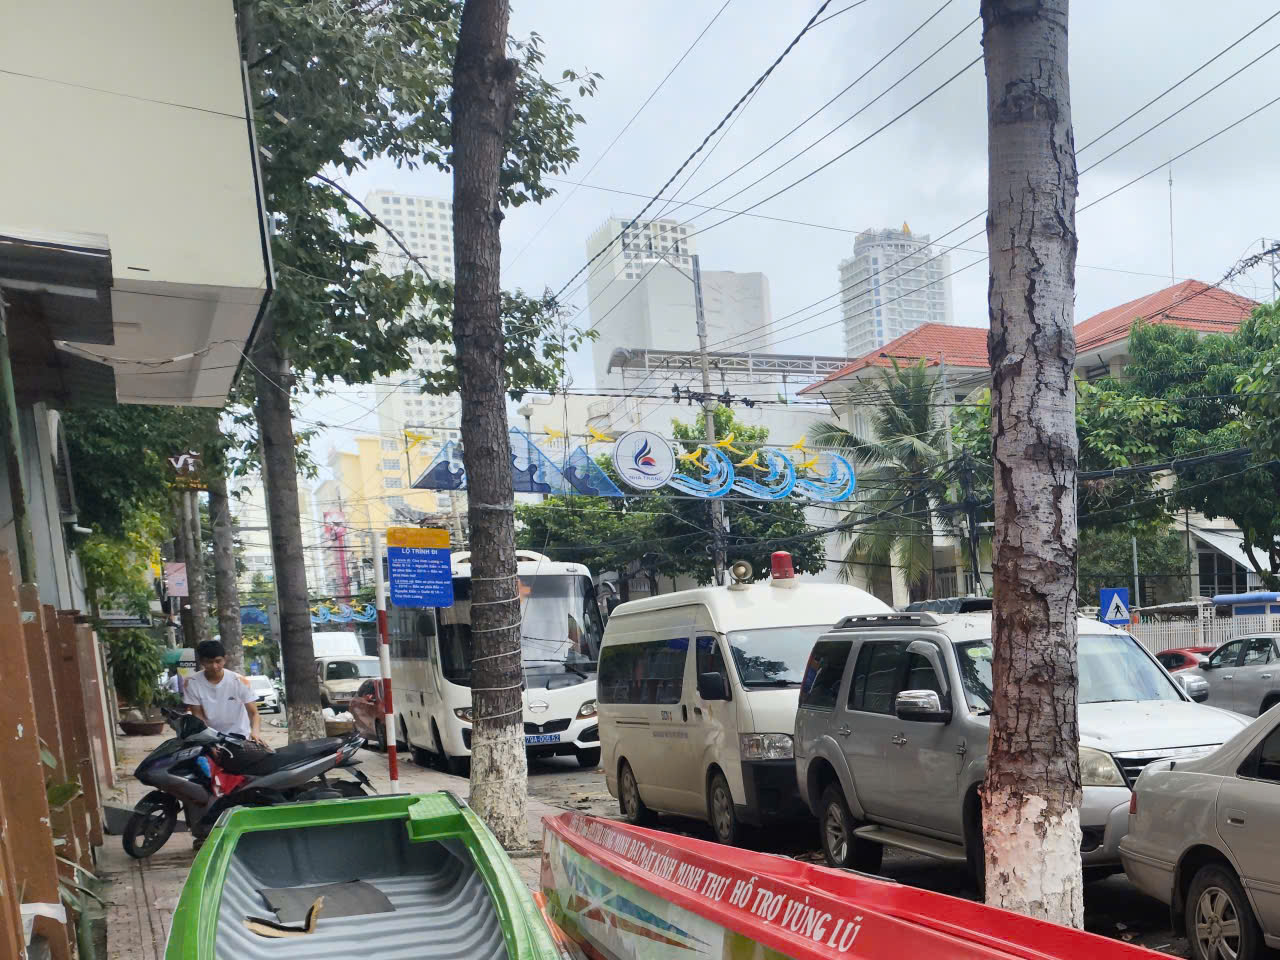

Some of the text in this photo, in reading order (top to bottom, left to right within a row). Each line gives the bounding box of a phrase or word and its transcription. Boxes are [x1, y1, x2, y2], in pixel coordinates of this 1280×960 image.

[673, 861, 706, 892] MINH
[700, 871, 733, 902] THƯ
[729, 876, 759, 909] HỖ
[751, 887, 787, 924] TRỢ
[781, 896, 832, 942] VÙNG
[826, 916, 864, 952] LŨ
